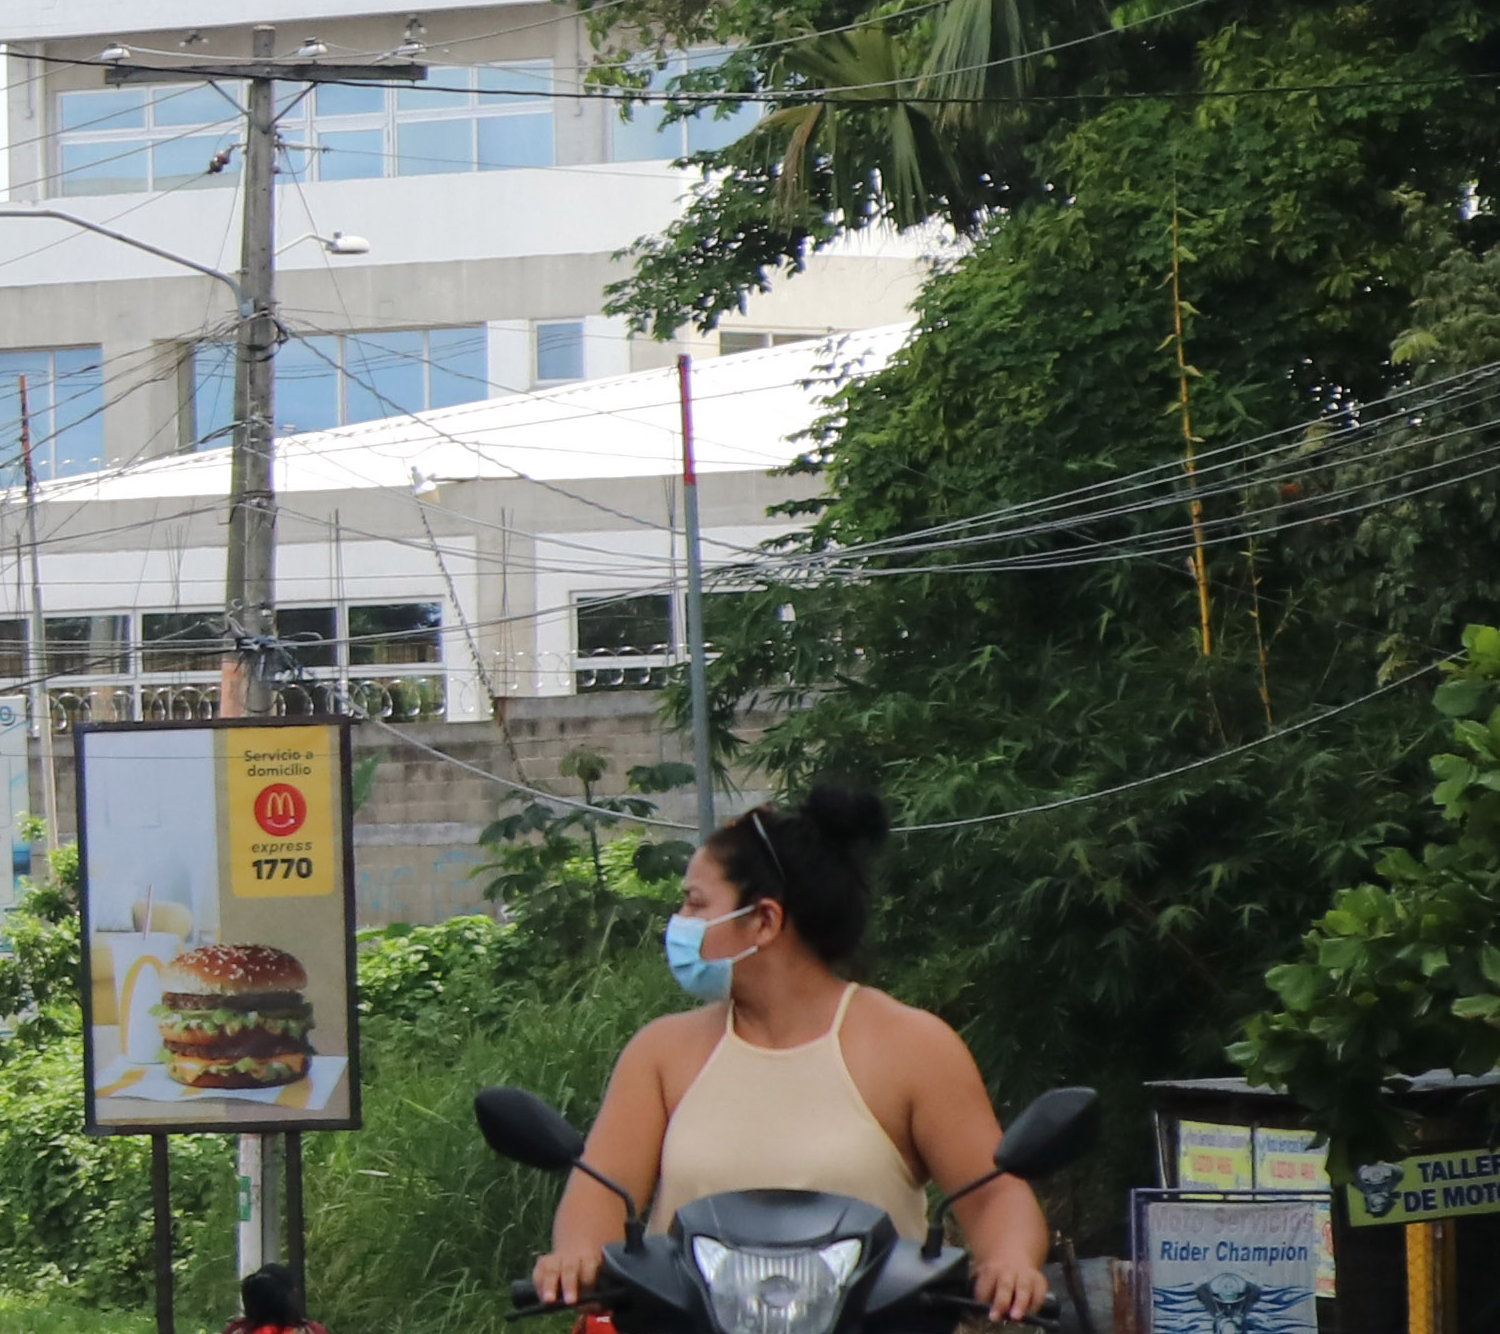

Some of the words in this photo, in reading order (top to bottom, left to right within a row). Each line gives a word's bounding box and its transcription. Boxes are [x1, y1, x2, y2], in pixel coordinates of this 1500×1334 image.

[244, 748, 301, 762] Servicio
[305, 750, 314, 760] a
[247, 765, 312, 777] domicilio
[251, 841, 313, 855] express
[252, 857, 313, 880] 1770
[1404, 1189, 1438, 1213] DE
[1443, 1183, 1500, 1209] MOT
[1160, 1240, 1210, 1261] Rider
[1216, 1240, 1308, 1266] Champion
